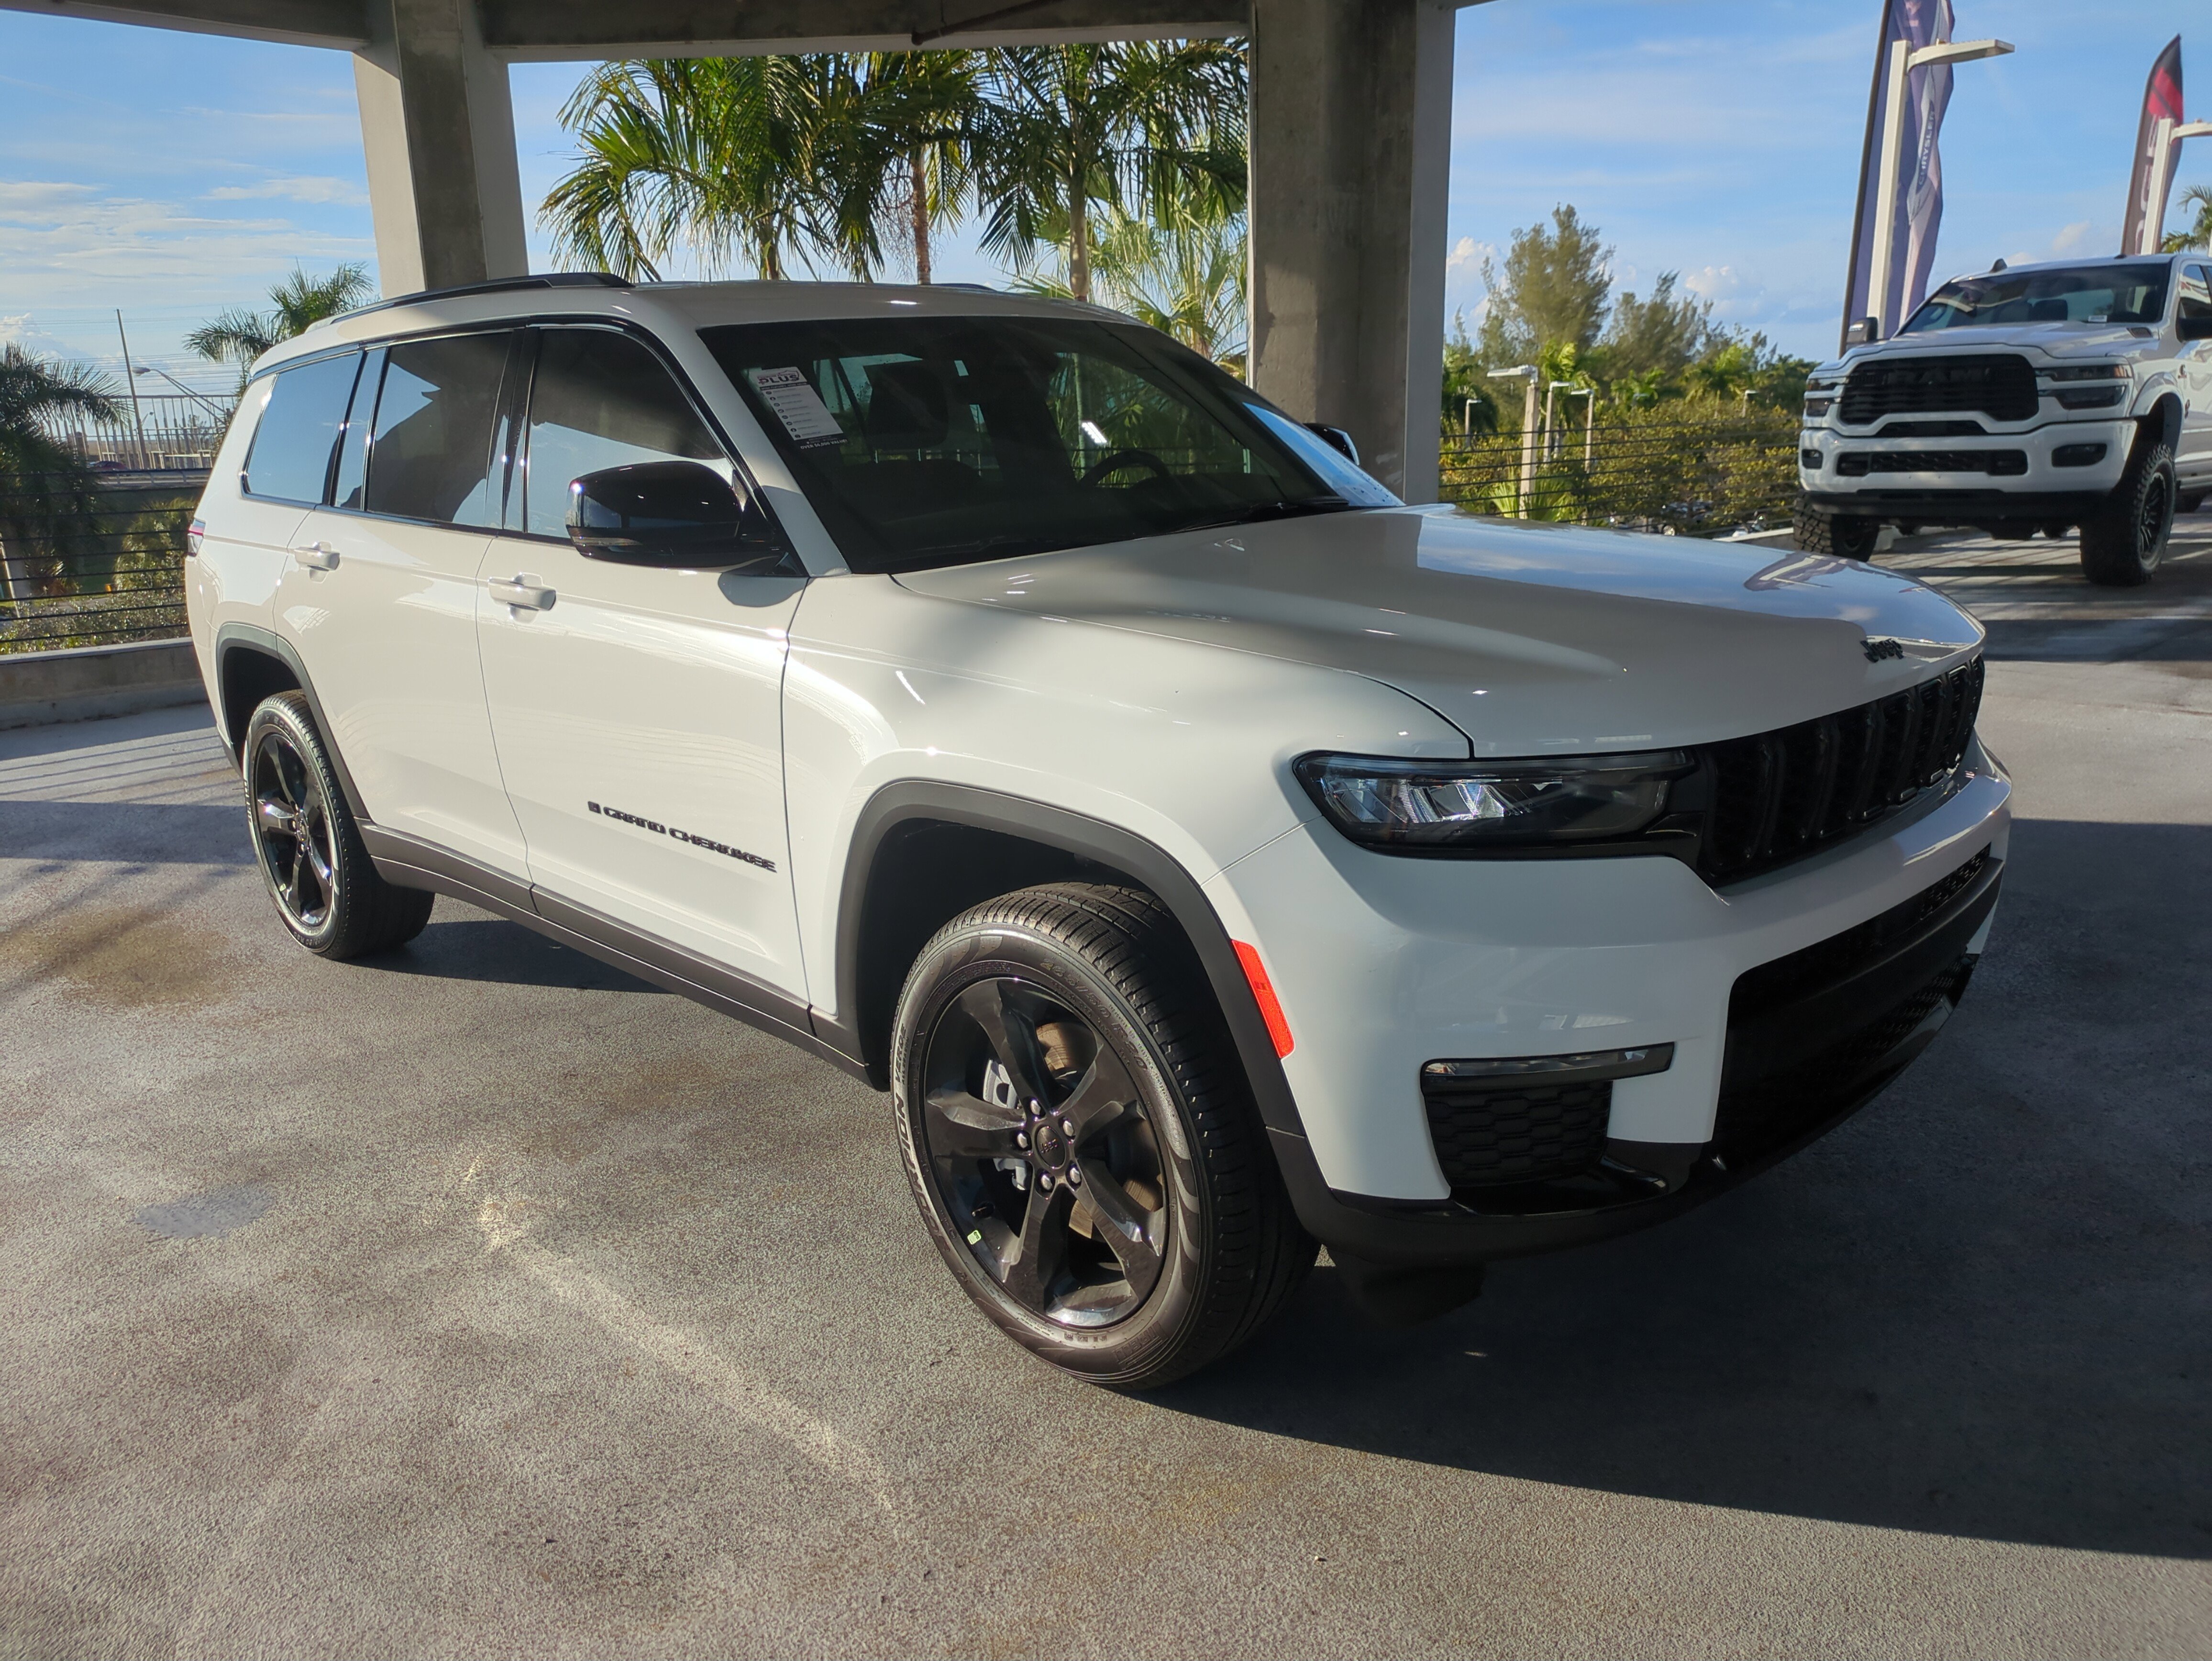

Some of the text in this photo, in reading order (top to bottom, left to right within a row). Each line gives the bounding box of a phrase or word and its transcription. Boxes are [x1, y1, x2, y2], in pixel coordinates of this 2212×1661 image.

[1919, 111, 1935, 186] CHRYSLER
[758, 375, 799, 385] PLUS
[1887, 368, 1983, 385] RAM
[603, 807, 777, 873] GRAND CHEROKEE
[896, 1091, 951, 1252] SCORPION
[1112, 1320, 1169, 1371] PIRELLI
